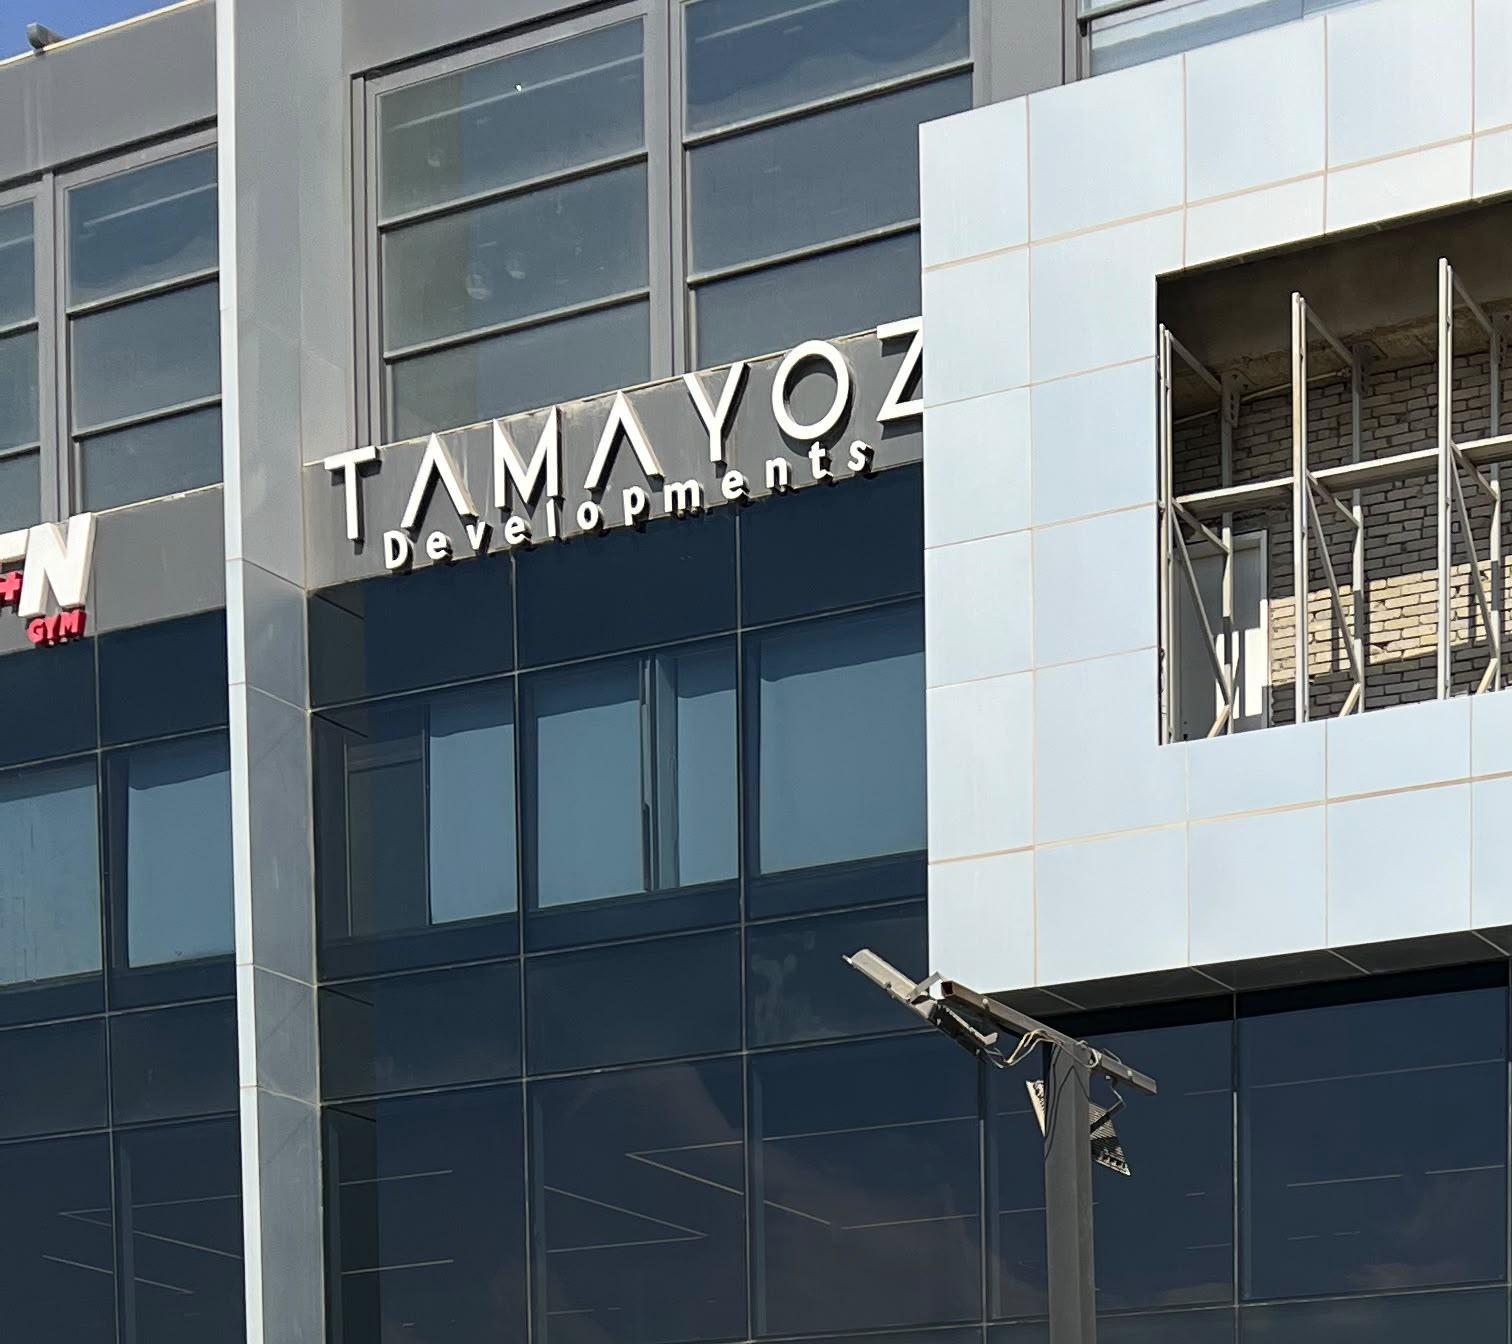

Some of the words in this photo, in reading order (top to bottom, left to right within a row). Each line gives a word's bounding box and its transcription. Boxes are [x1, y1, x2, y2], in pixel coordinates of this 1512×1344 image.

[324, 316, 923, 541] TAMAYOZ
[383, 439, 871, 572] Developments
[27, 608, 85, 645] GYM
